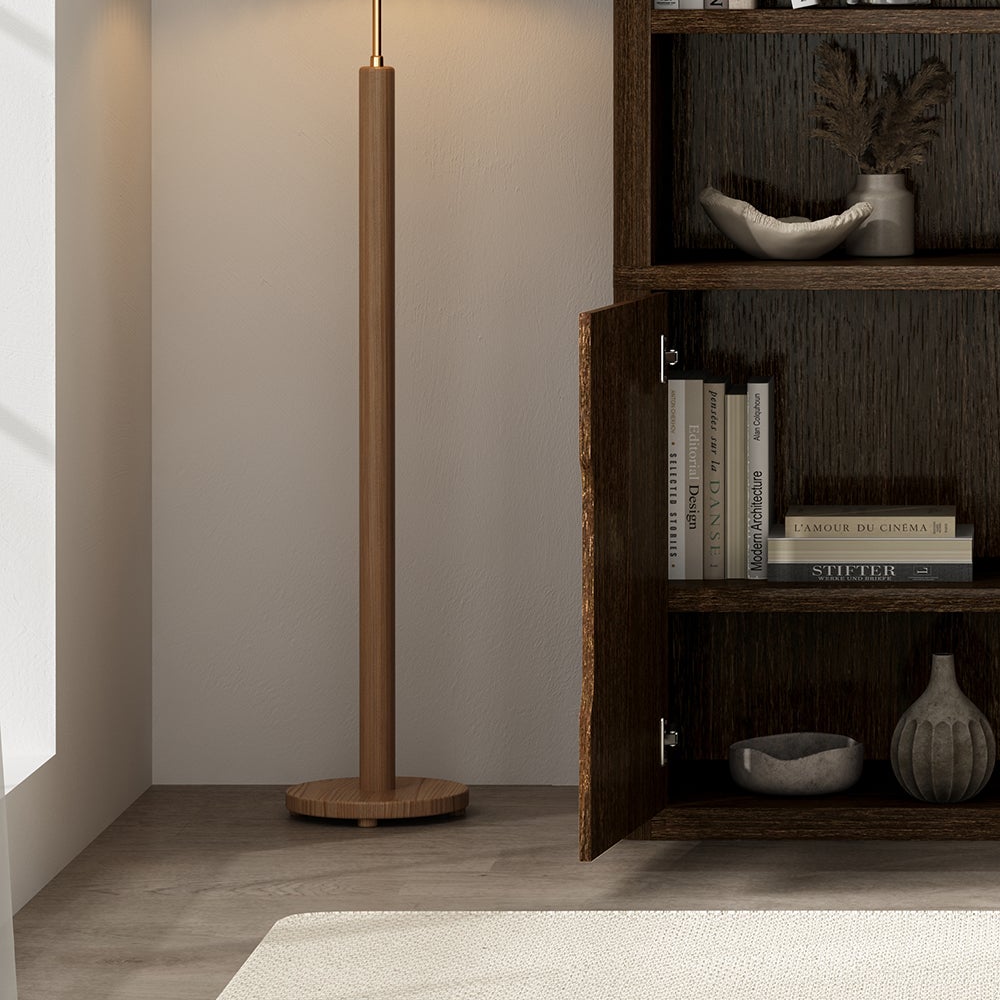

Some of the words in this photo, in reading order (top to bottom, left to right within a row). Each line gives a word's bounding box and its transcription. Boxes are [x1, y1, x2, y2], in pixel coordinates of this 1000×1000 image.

[708, 390, 718, 431] pensées
[688, 424, 700, 480] Editorial
[711, 460, 720, 472] la
[669, 453, 677, 505] SELECTED
[751, 471, 763, 530] Architecture
[686, 485, 700, 530] Design
[709, 480, 720, 556] DANSE
[794, 523, 850, 532] L'AMOUR
[857, 523, 874, 532] DU
[669, 512, 677, 557] STORIES
[751, 531, 763, 571] Modern
[812, 565, 896, 576] STIFTER
